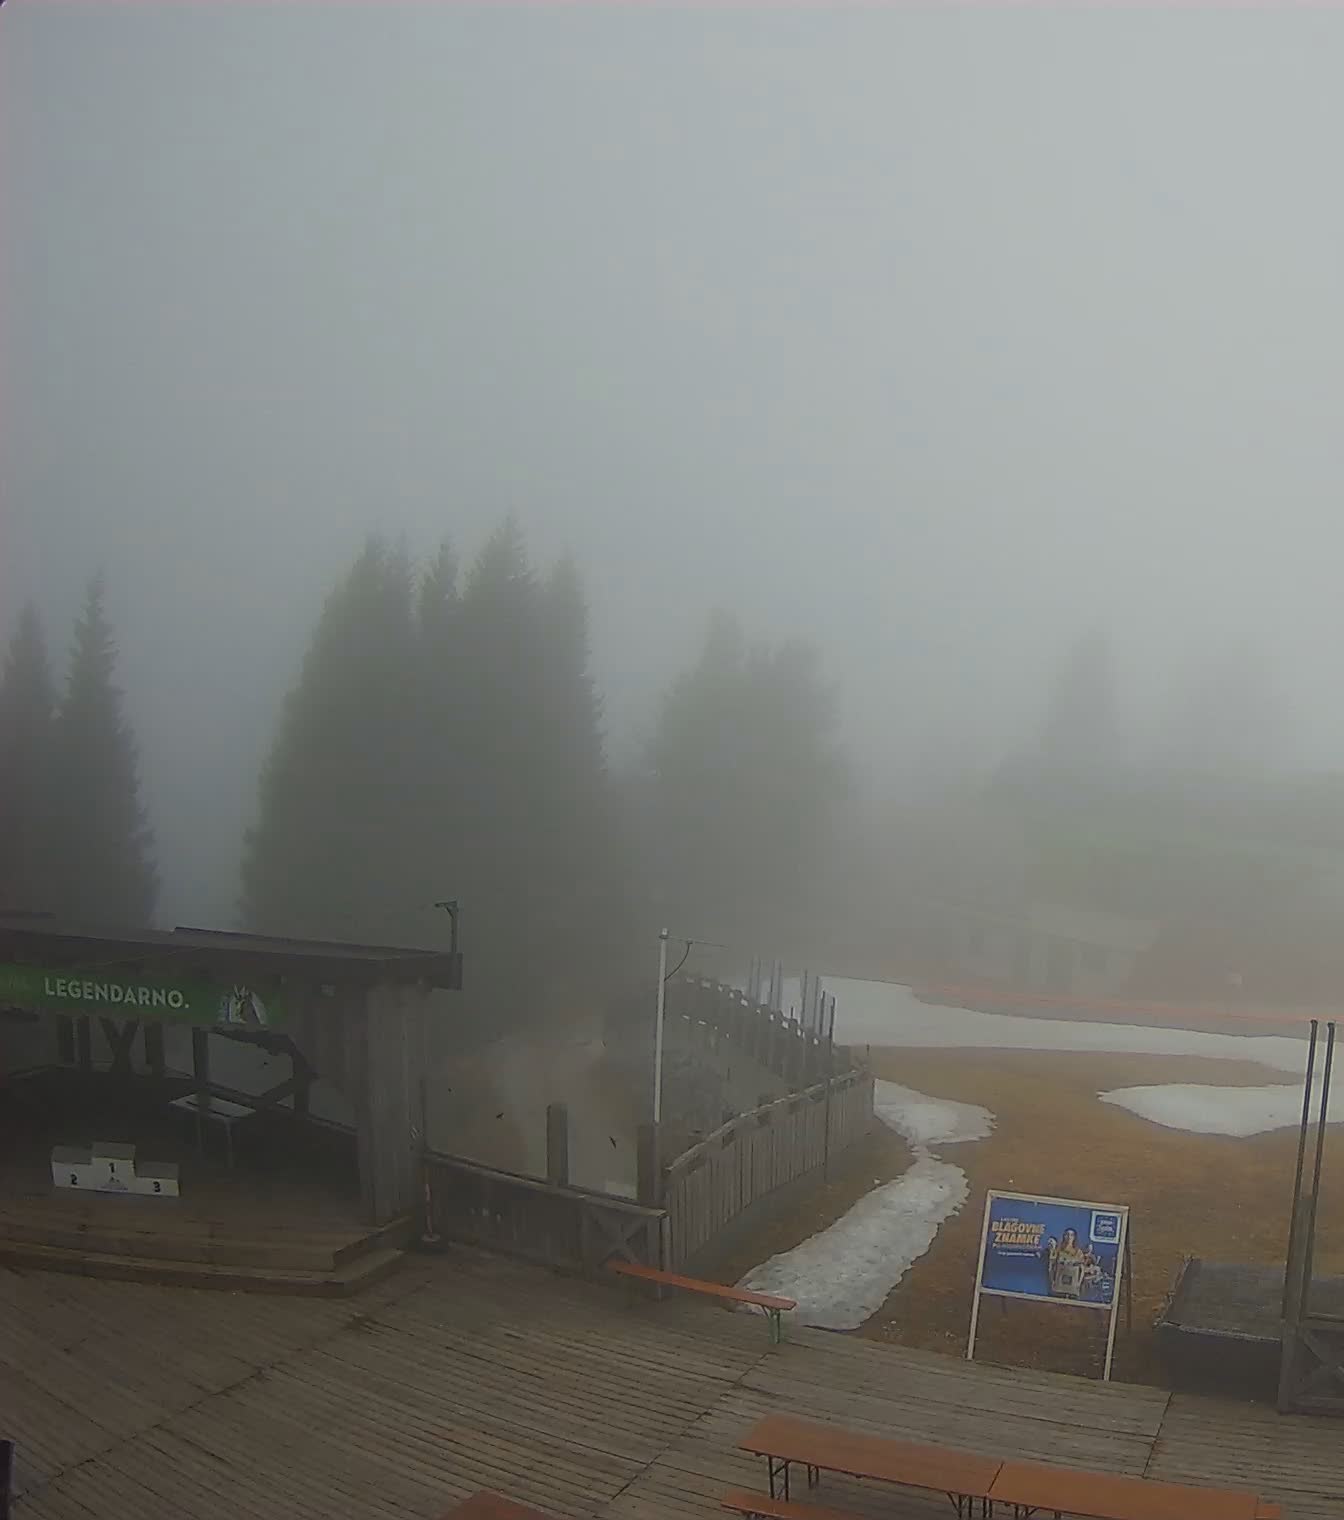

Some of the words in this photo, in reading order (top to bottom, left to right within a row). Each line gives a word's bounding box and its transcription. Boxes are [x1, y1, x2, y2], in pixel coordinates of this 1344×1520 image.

[44, 977, 190, 1009] LEGENDARNO.
[109, 1162, 116, 1174] 1
[70, 1173, 78, 1185] 2
[152, 1181, 161, 1193] 3
[995, 1232, 1041, 1244] ZNAMKE
